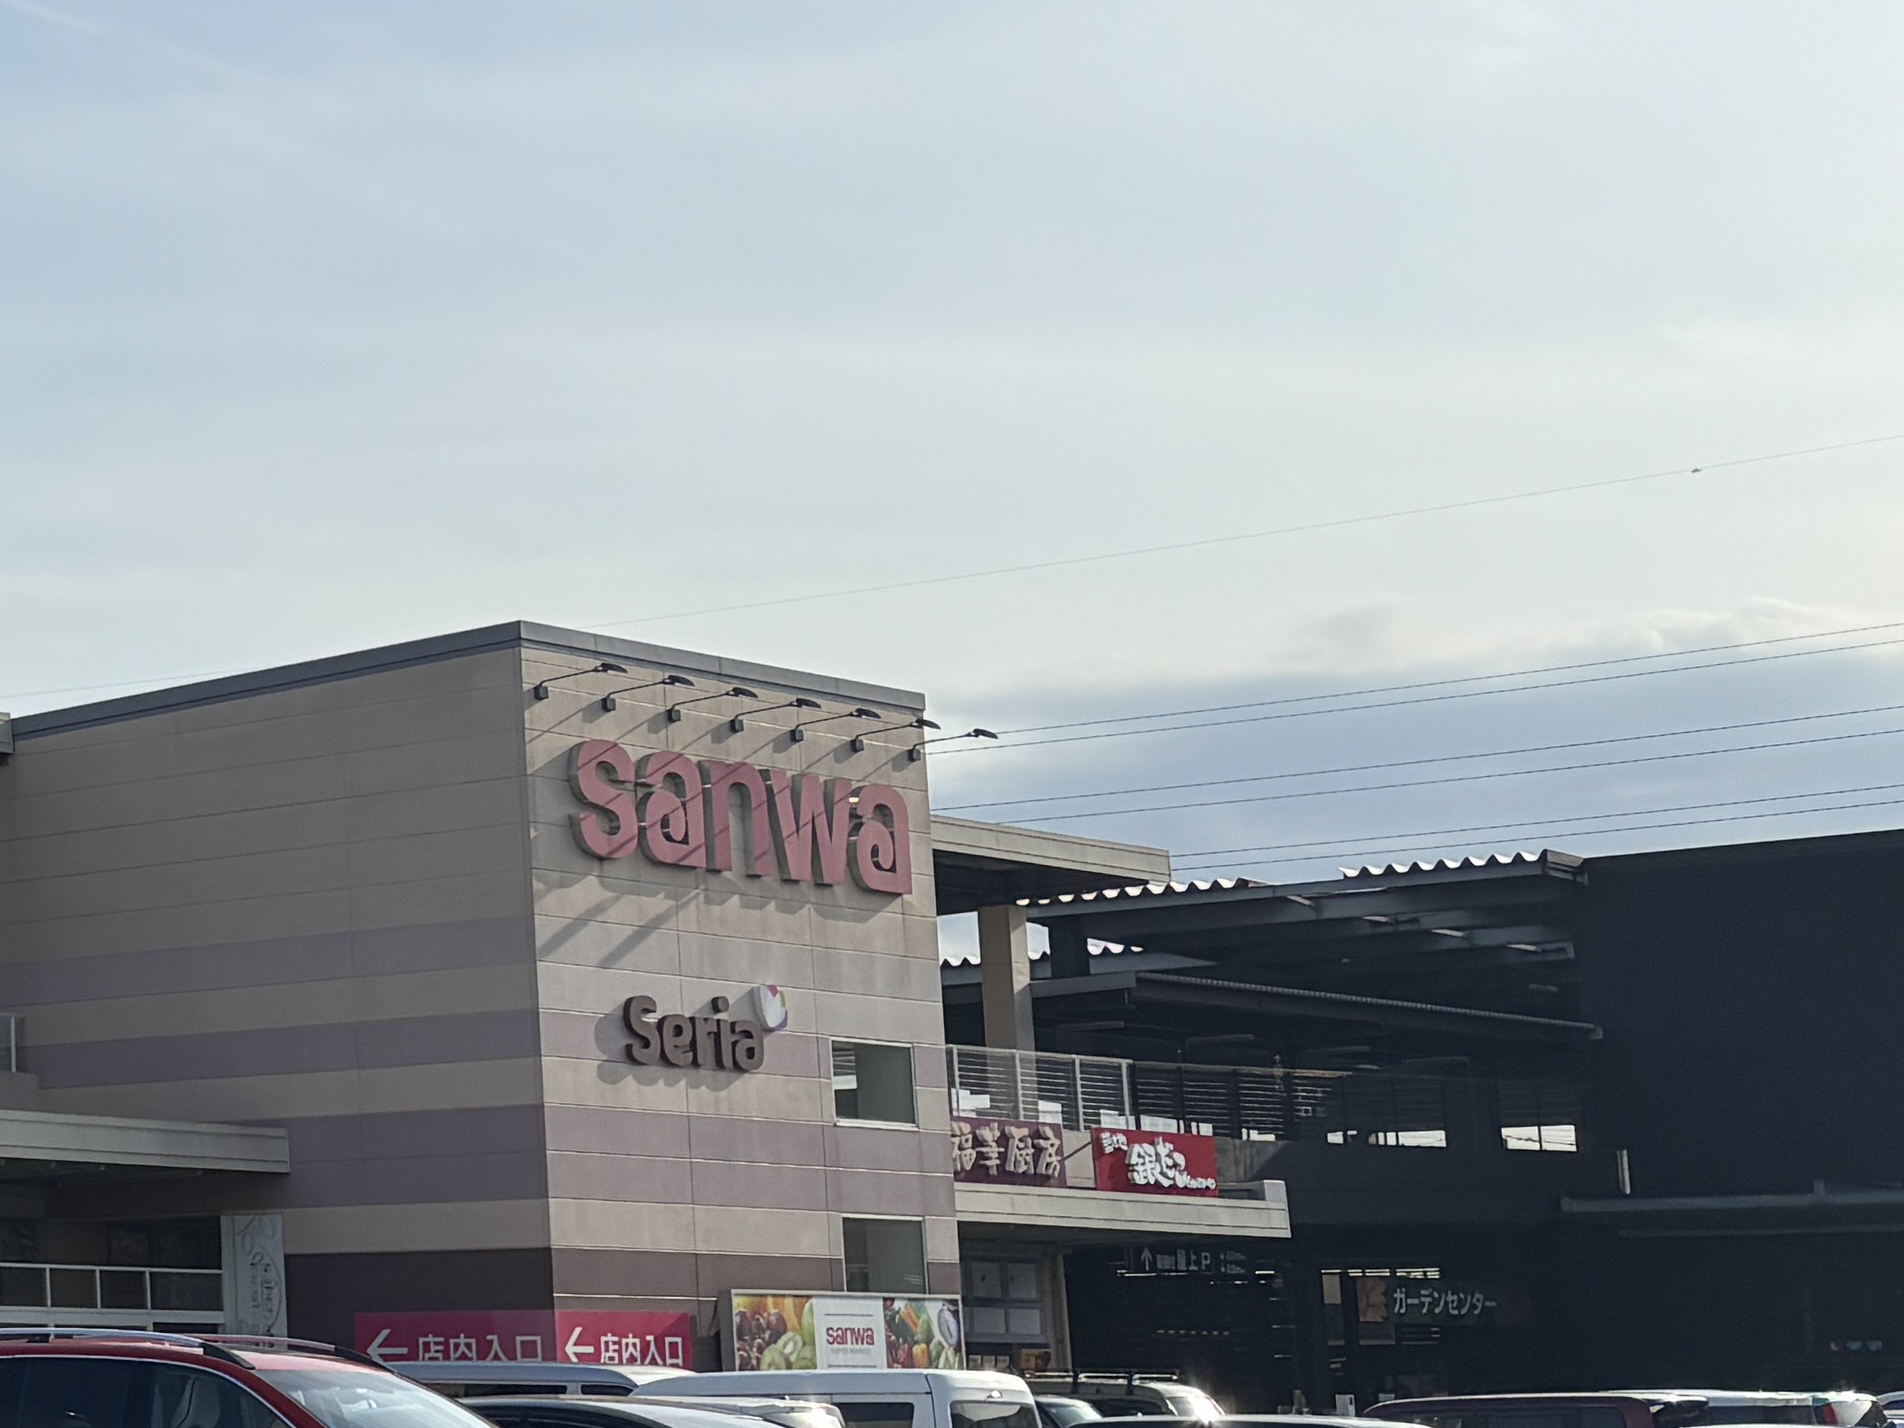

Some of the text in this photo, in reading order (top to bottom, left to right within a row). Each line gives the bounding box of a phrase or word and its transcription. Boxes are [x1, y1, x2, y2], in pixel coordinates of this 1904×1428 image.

[570, 739, 913, 894] sanwa
[623, 995, 764, 1071] Seria
[1393, 1288, 1497, 1315] ガーデンセンター
[418, 1334, 542, 1362] 店内入口
[600, 1333, 683, 1367] 店内入口
[826, 1327, 875, 1345] sanwa
